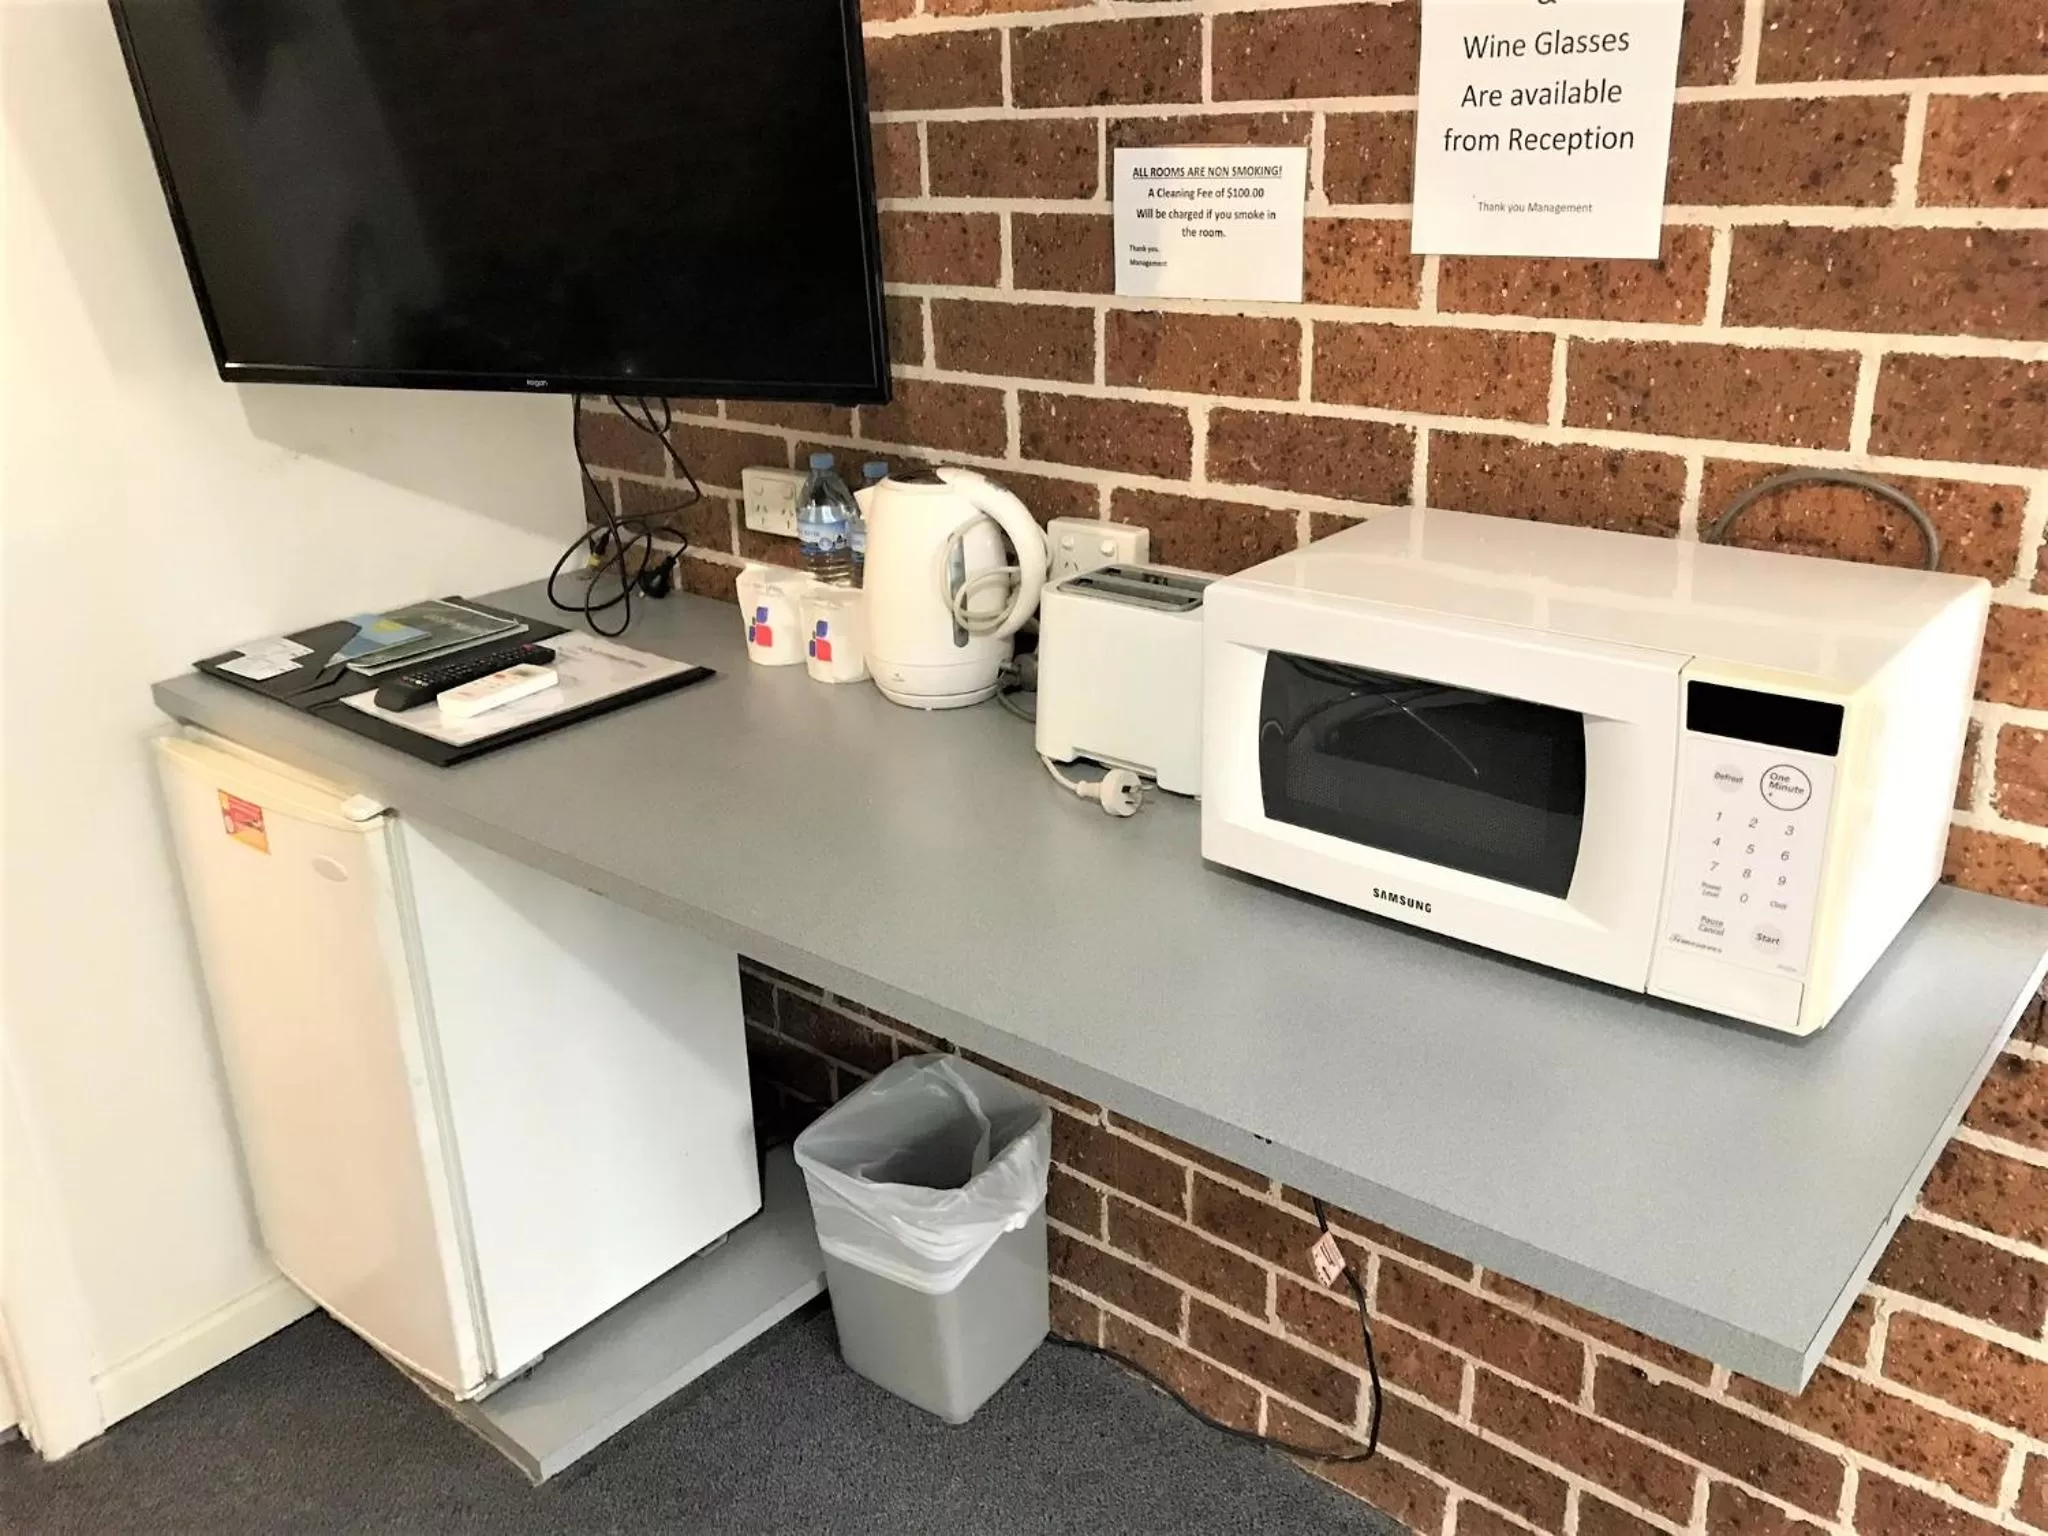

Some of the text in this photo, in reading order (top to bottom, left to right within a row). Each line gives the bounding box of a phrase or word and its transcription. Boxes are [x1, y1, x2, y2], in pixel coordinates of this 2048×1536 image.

[1463, 29, 1630, 59] Wine Glasses
[1461, 78, 1623, 108] Are available
[1444, 126, 1635, 156] from Reception
[1132, 165, 1283, 177] ALL ROOMS ARE NON SMOKING!
[1148, 187, 1265, 201] A Cleaning Fee of $100.00
[1478, 201, 1593, 215] Thank you Management
[1136, 208, 1276, 222] Will be charged if you smoke in
[1181, 228, 1226, 238] the room.
[1129, 244, 1147, 253] Thank
[1129, 258, 1168, 267] Management
[1769, 772, 1791, 783] One
[1769, 781, 1805, 794] Minute
[1716, 811, 1723, 822] 1
[1748, 817, 1759, 829] 2
[1785, 825, 1795, 837] 3
[1712, 837, 1721, 847] 4
[1745, 843, 1755, 855] 5
[1780, 851, 1790, 862] 6
[1710, 861, 1719, 872] 7
[1742, 868, 1752, 880] 8
[1777, 875, 1787, 887] 9
[1373, 888, 1432, 913] SAMSUNG
[1739, 893, 1749, 904] 0
[1755, 932, 1781, 946] Start
